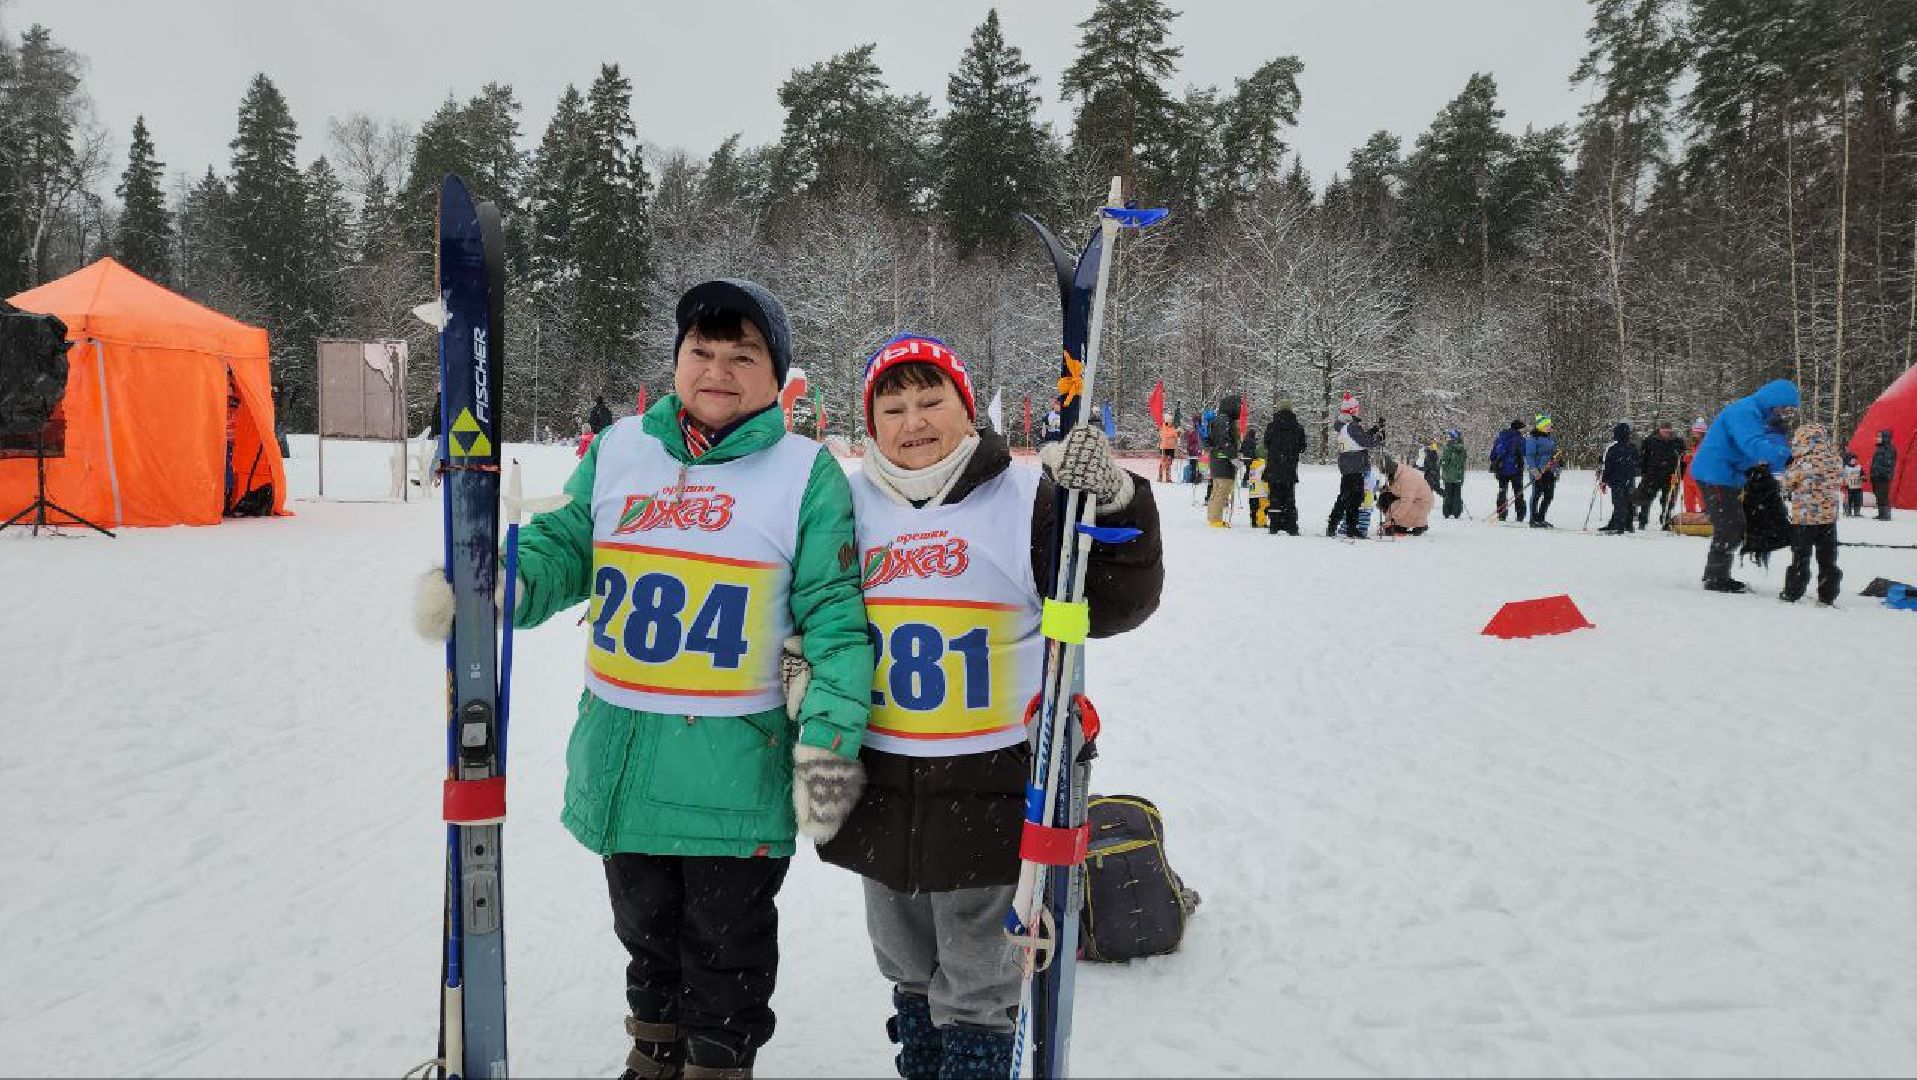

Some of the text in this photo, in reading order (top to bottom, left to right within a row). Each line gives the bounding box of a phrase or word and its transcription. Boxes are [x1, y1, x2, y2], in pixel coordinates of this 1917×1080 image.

[473, 326, 489, 423] FISCHER
[662, 485, 715, 496] оршки
[593, 566, 749, 668] 284
